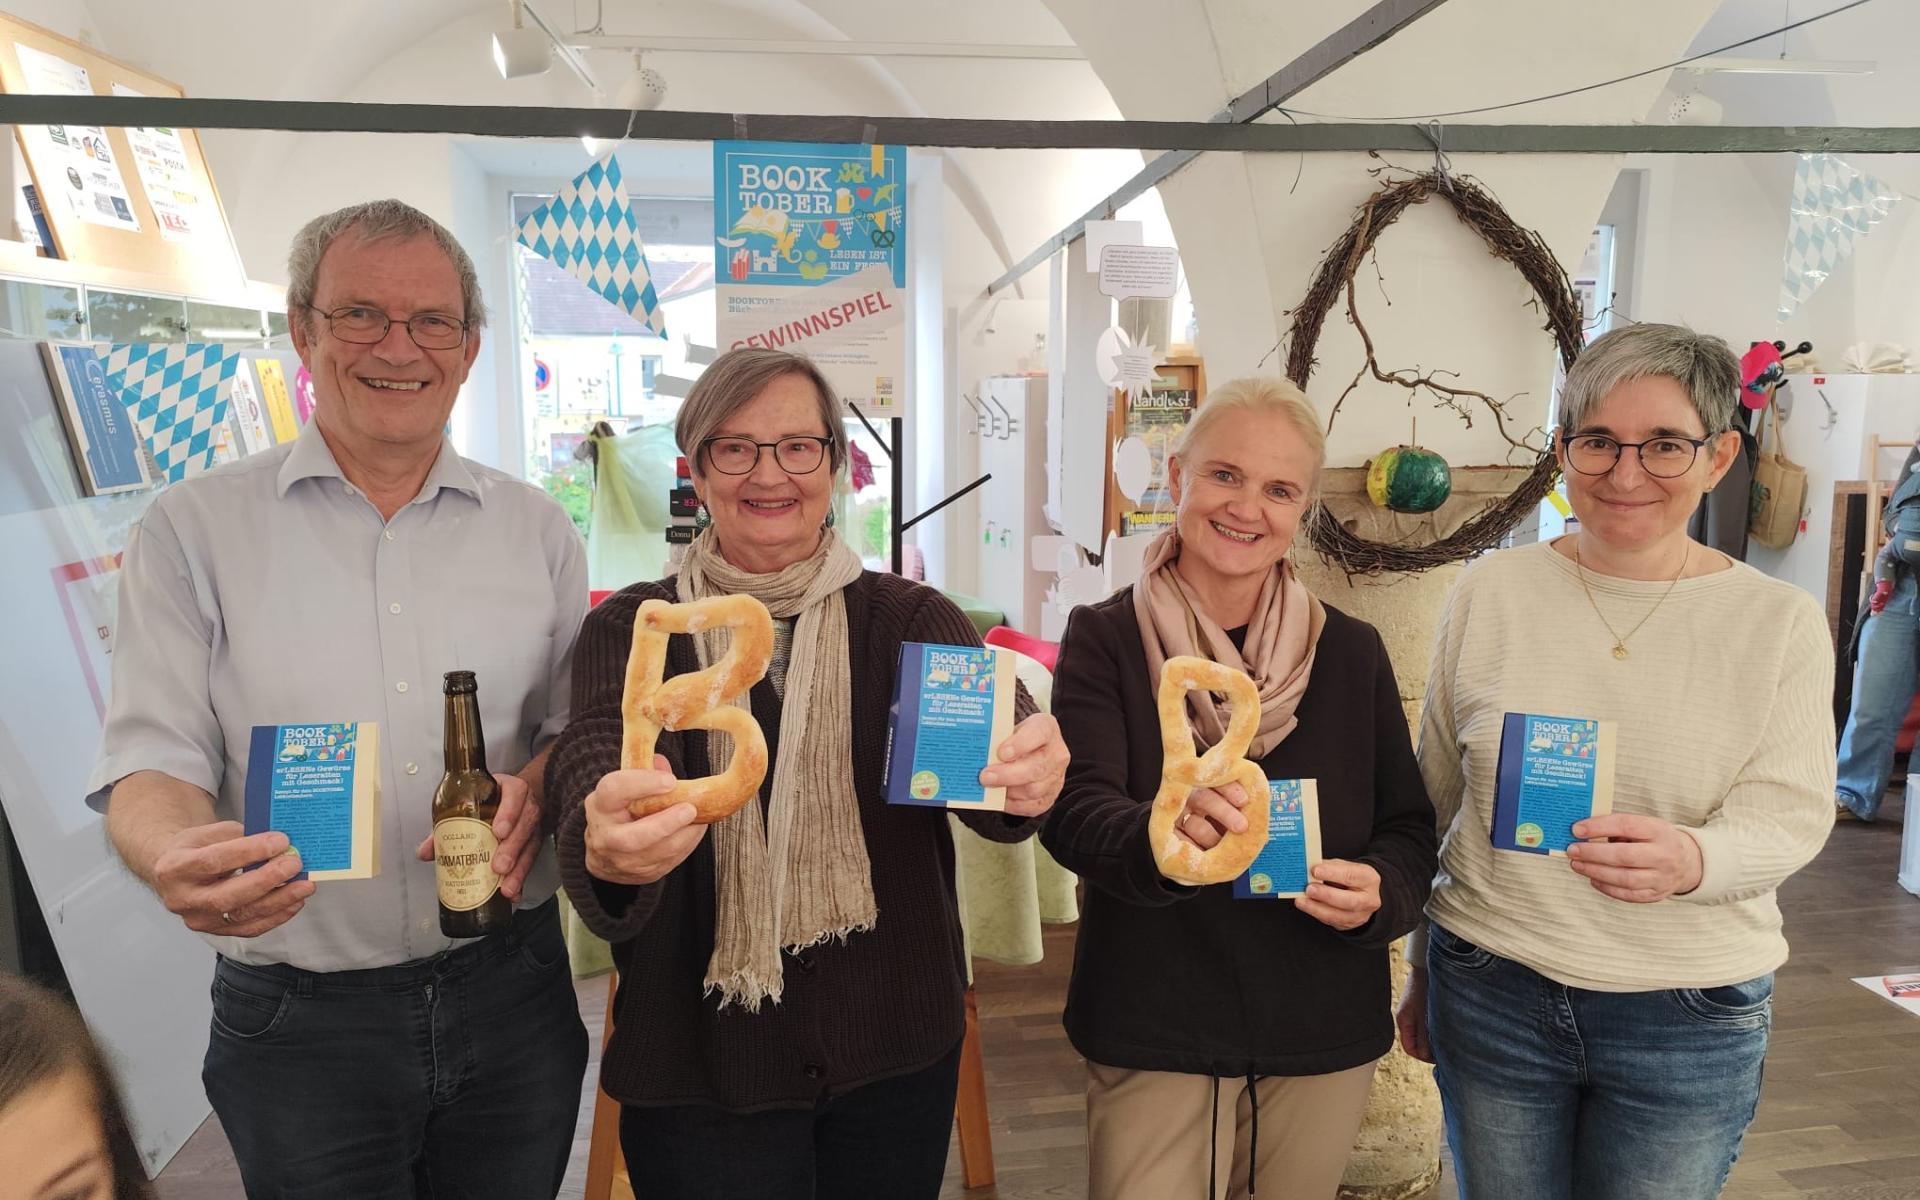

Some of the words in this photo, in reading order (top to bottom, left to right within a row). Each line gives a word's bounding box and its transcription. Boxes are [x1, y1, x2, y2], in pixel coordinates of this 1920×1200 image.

[738, 164, 832, 192] BOOK
[739, 192, 832, 214] TOBER
[670, 530, 691, 538] Donna
[930, 652, 968, 664] BOOK
[284, 727, 326, 738] BOOK
[1533, 721, 1572, 734] BOOK
